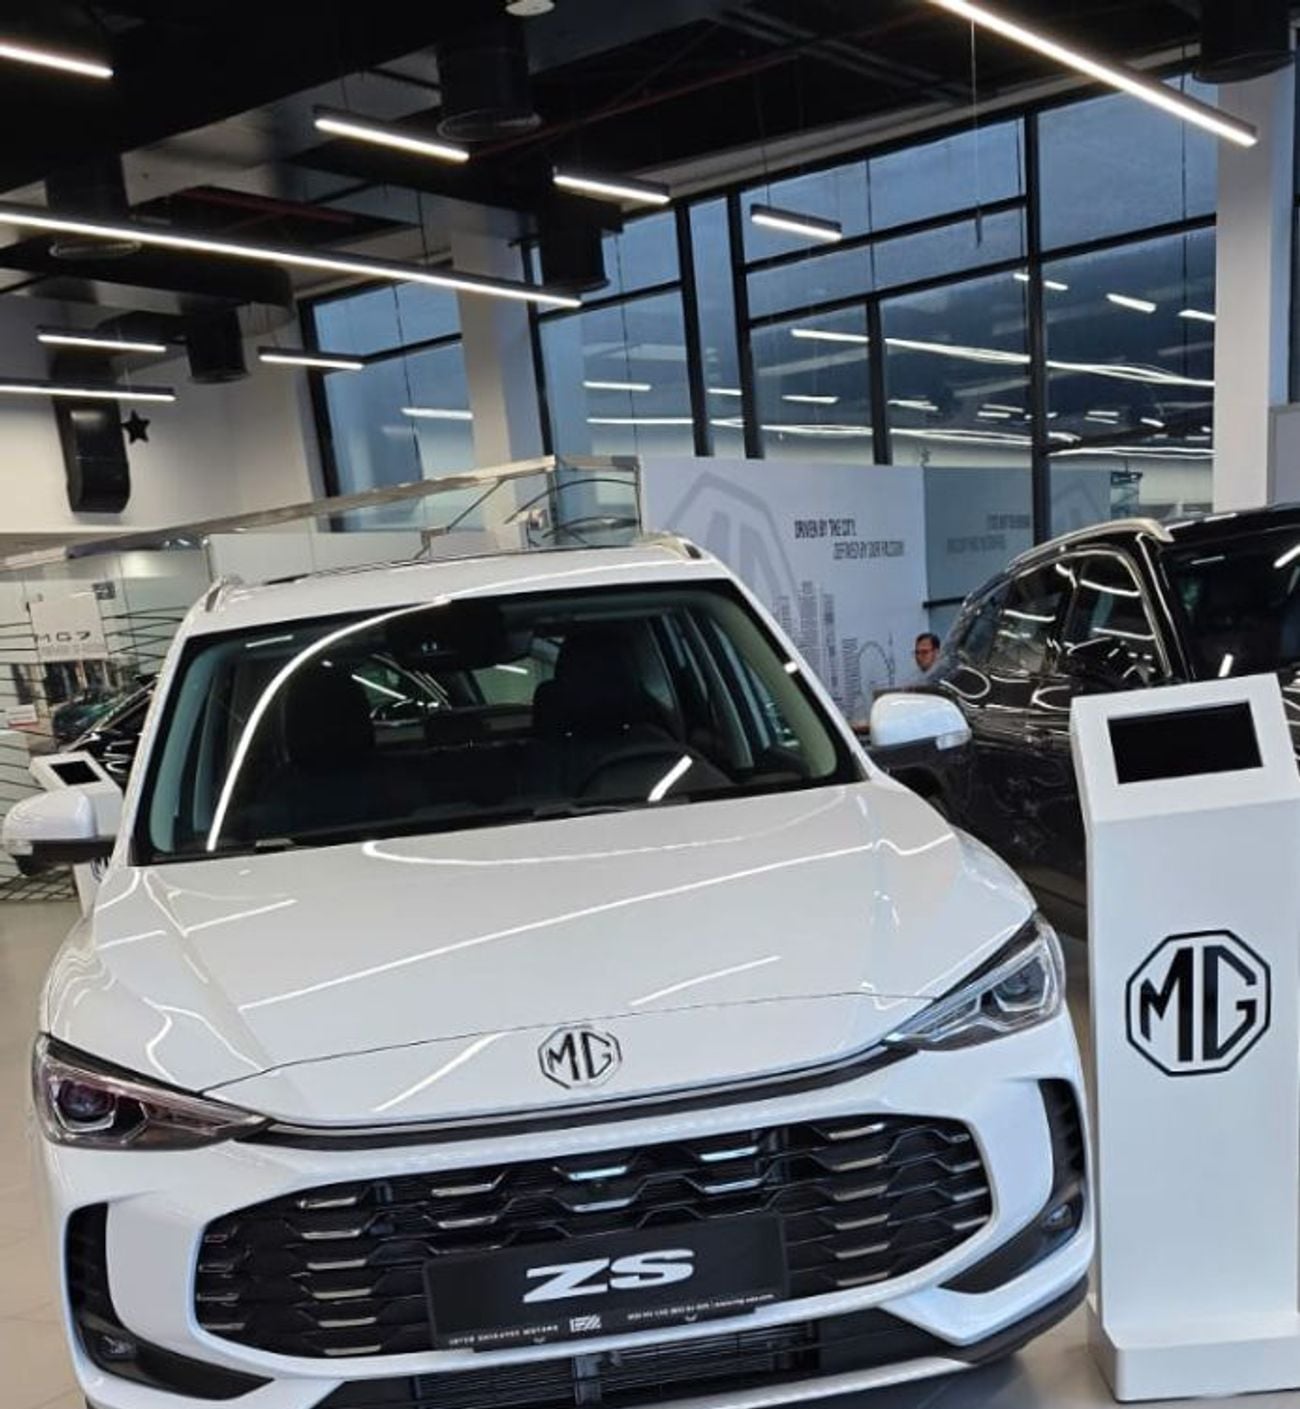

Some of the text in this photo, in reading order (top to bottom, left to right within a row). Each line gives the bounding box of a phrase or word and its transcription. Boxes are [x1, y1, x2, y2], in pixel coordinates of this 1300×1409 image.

[34, 631, 90, 643] MG7
[1139, 945, 1257, 1062] MG
[546, 1031, 612, 1080] MG
[523, 1249, 694, 1303] ZS
